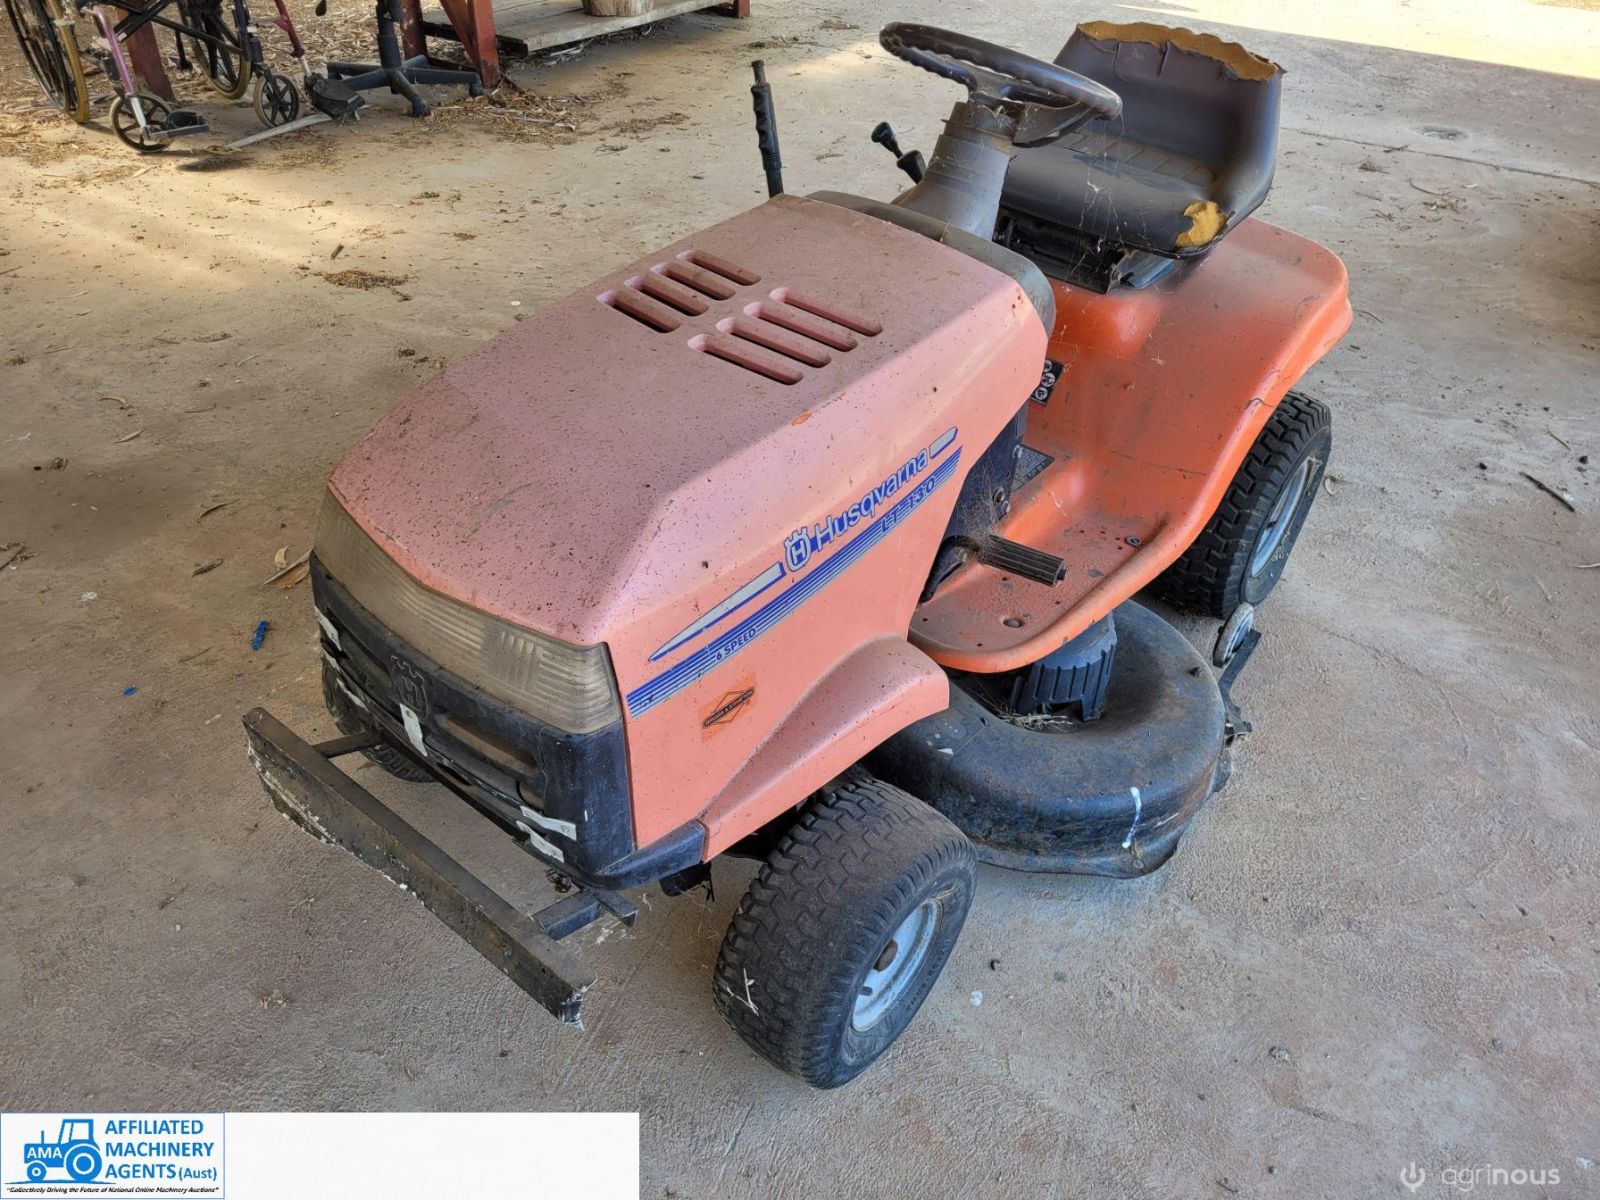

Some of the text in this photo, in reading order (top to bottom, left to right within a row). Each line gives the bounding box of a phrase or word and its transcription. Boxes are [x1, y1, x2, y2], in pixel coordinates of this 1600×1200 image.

[814, 448, 928, 552] Husqvarna
[881, 477, 935, 533] LT 130
[724, 628, 756, 655] SPEED
